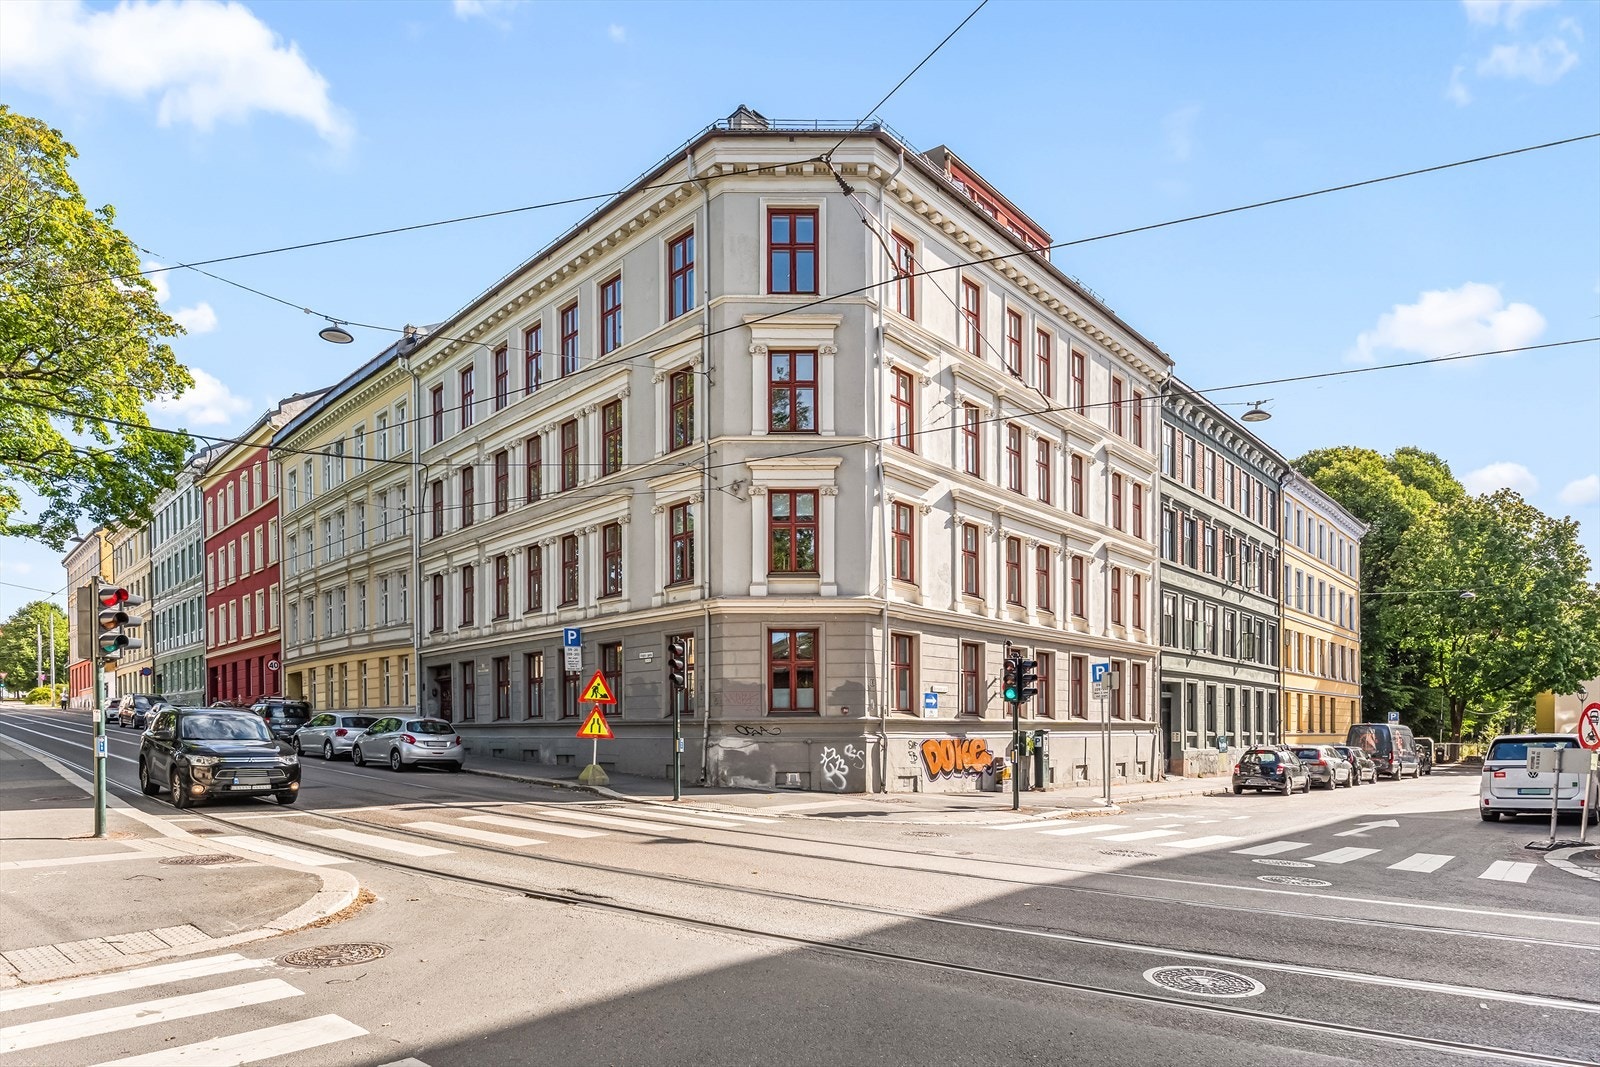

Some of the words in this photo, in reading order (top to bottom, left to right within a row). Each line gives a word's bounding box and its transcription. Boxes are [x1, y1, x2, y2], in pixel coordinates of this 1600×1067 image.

[568, 630, 577, 645] P
[1095, 666, 1106, 681] P
[1390, 713, 1397, 721] P
[1035, 738, 1041, 746] P
